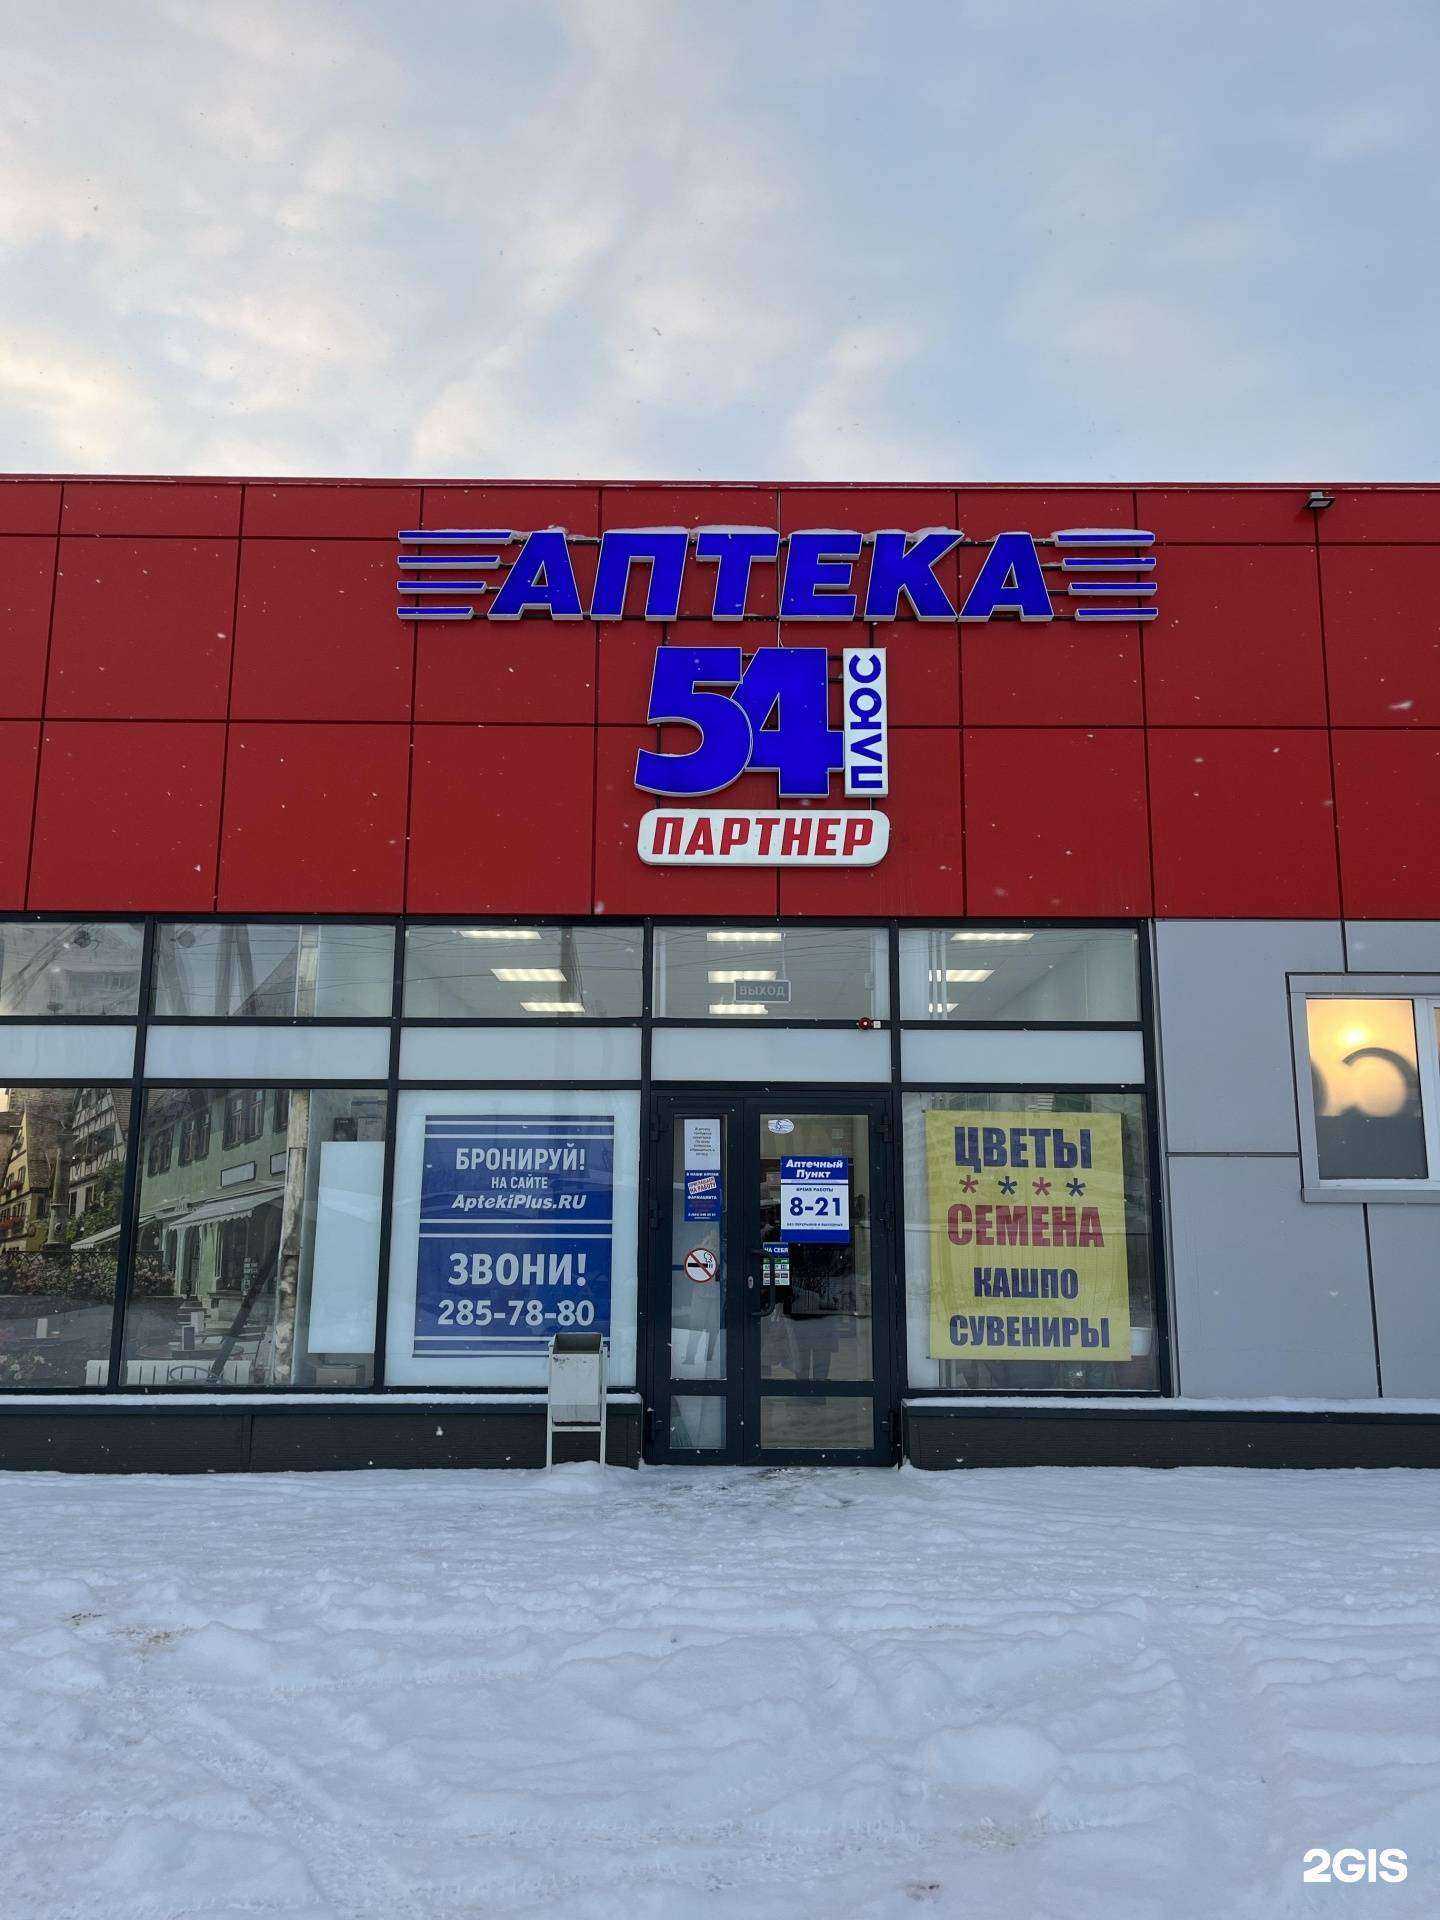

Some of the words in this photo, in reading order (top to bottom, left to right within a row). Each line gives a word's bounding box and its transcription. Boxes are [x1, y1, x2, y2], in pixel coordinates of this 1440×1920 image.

[487, 530, 1054, 623] АПТЕКА
[634, 646, 845, 798] 54
[848, 653, 883, 790] ПЛЮС
[650, 817, 874, 857] ПАРТНЕР
[739, 985, 785, 997] ВЫХОД
[455, 1142, 586, 1171] БРОНИРУЙ!
[785, 1159, 844, 1169] Аптечный
[954, 1126, 1093, 1174] ЦВЕТЫ
[491, 1176, 506, 1189] НА
[510, 1174, 548, 1189] САЙТЕ
[796, 1169, 831, 1180] Пункт
[451, 1194, 587, 1211] AptekiPlus.RU
[789, 1196, 841, 1217] 8-21
[947, 1203, 1105, 1248] СЕМЕНА
[448, 1252, 587, 1287] ЗВОНИ!
[973, 1267, 1079, 1299] КАШПО
[437, 1299, 595, 1327] 285-78-80
[949, 1314, 1110, 1348] СУВЕНИРЫ
